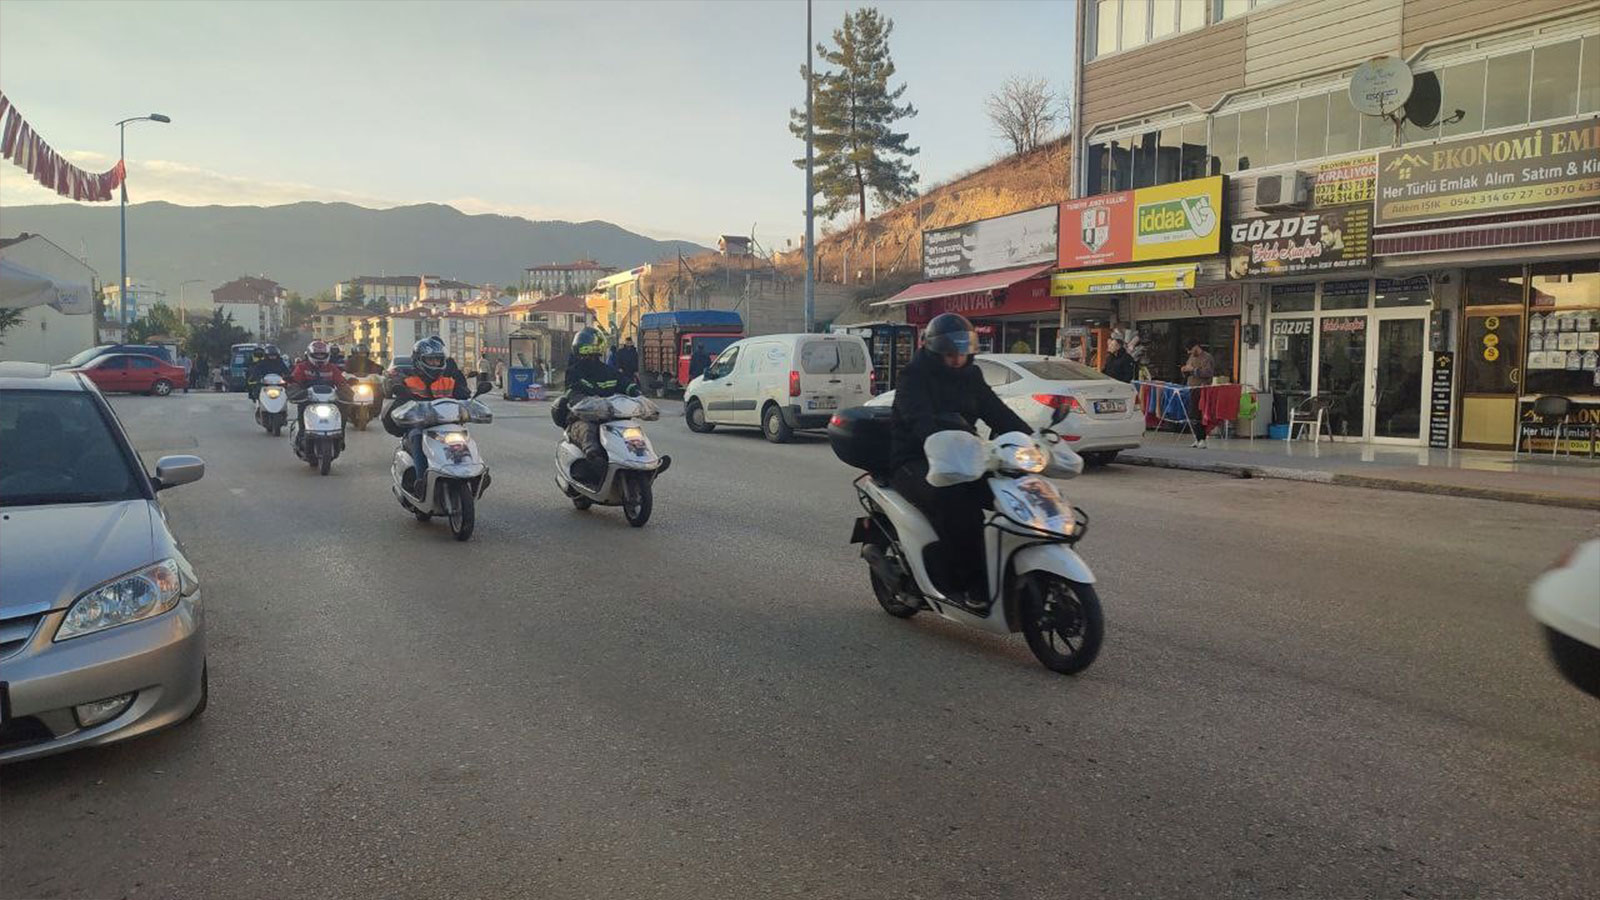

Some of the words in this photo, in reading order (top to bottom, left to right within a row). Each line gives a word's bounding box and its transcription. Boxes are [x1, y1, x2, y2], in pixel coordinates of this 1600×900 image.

[1432, 129, 1543, 172] EKONOMİ
[1315, 183, 1336, 195] 0370
[1383, 186, 1404, 199] Her
[1406, 179, 1437, 196] Türlü
[1440, 174, 1478, 191] Emlak
[1485, 171, 1515, 186] Alım
[1522, 166, 1562, 182] Satım
[1566, 161, 1578, 176] &
[1315, 193, 1336, 205] 0542
[1450, 196, 1476, 207] 0542
[1480, 193, 1500, 204] 314
[1502, 191, 1516, 201] 67
[1519, 189, 1534, 200] 27
[1544, 184, 1575, 196] 0370
[1140, 207, 1185, 232] iddaa
[1231, 214, 1320, 243] GÖZDE
